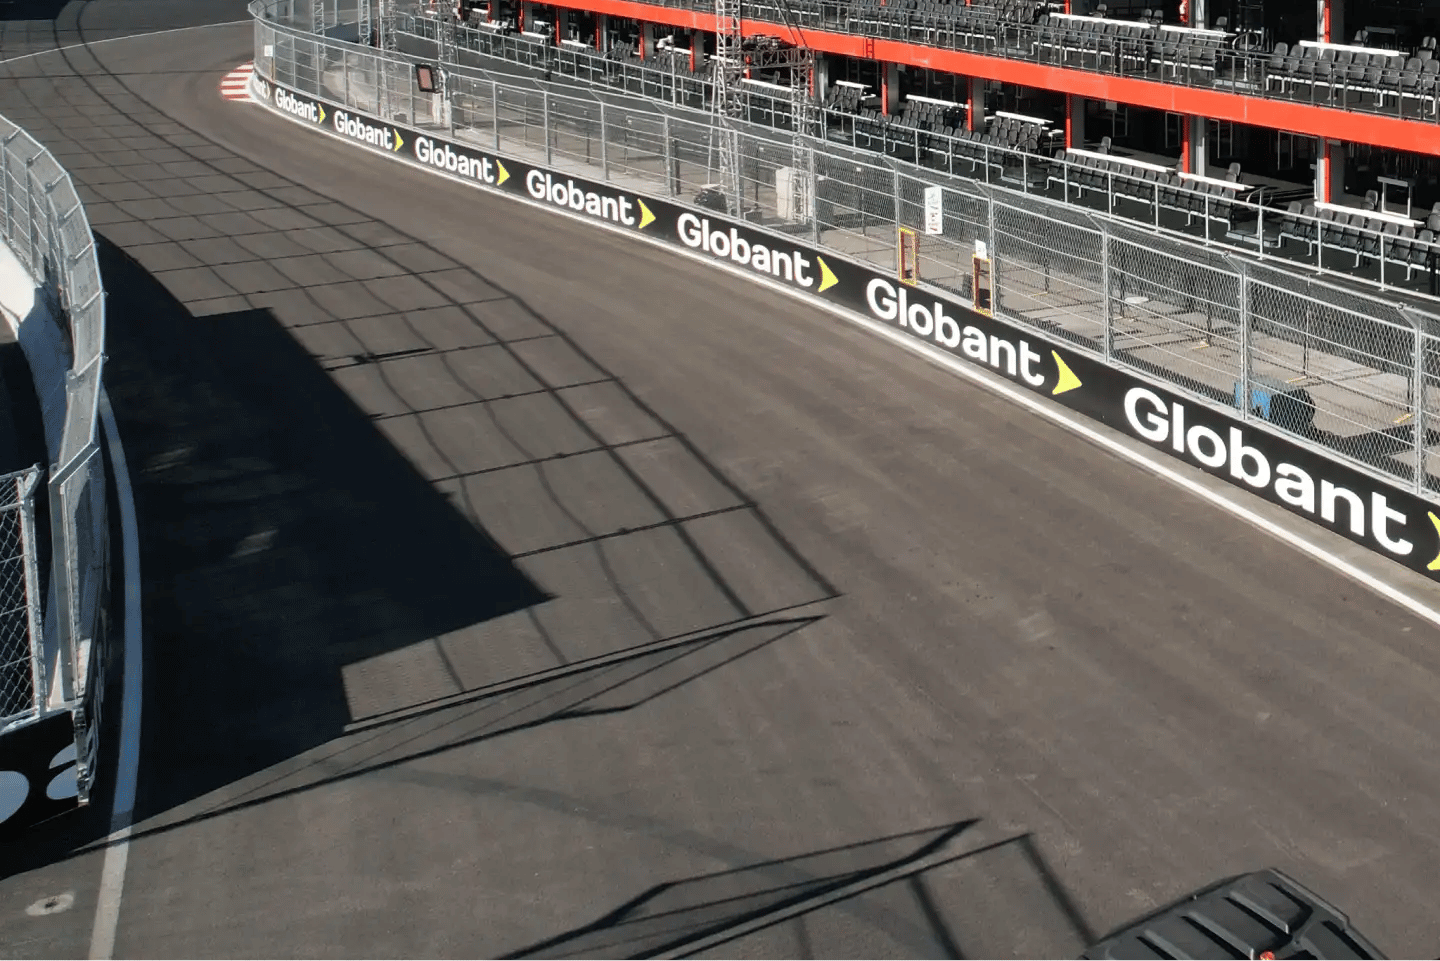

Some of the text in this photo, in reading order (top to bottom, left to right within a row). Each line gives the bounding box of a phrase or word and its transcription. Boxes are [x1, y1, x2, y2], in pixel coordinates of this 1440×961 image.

[274, 87, 318, 123] Globant
[333, 110, 393, 150] Globant
[415, 136, 495, 184] Globant
[526, 169, 636, 227] Globant
[677, 212, 814, 288] Globant
[866, 278, 1046, 387] Globant
[1124, 387, 1414, 556] Globant
